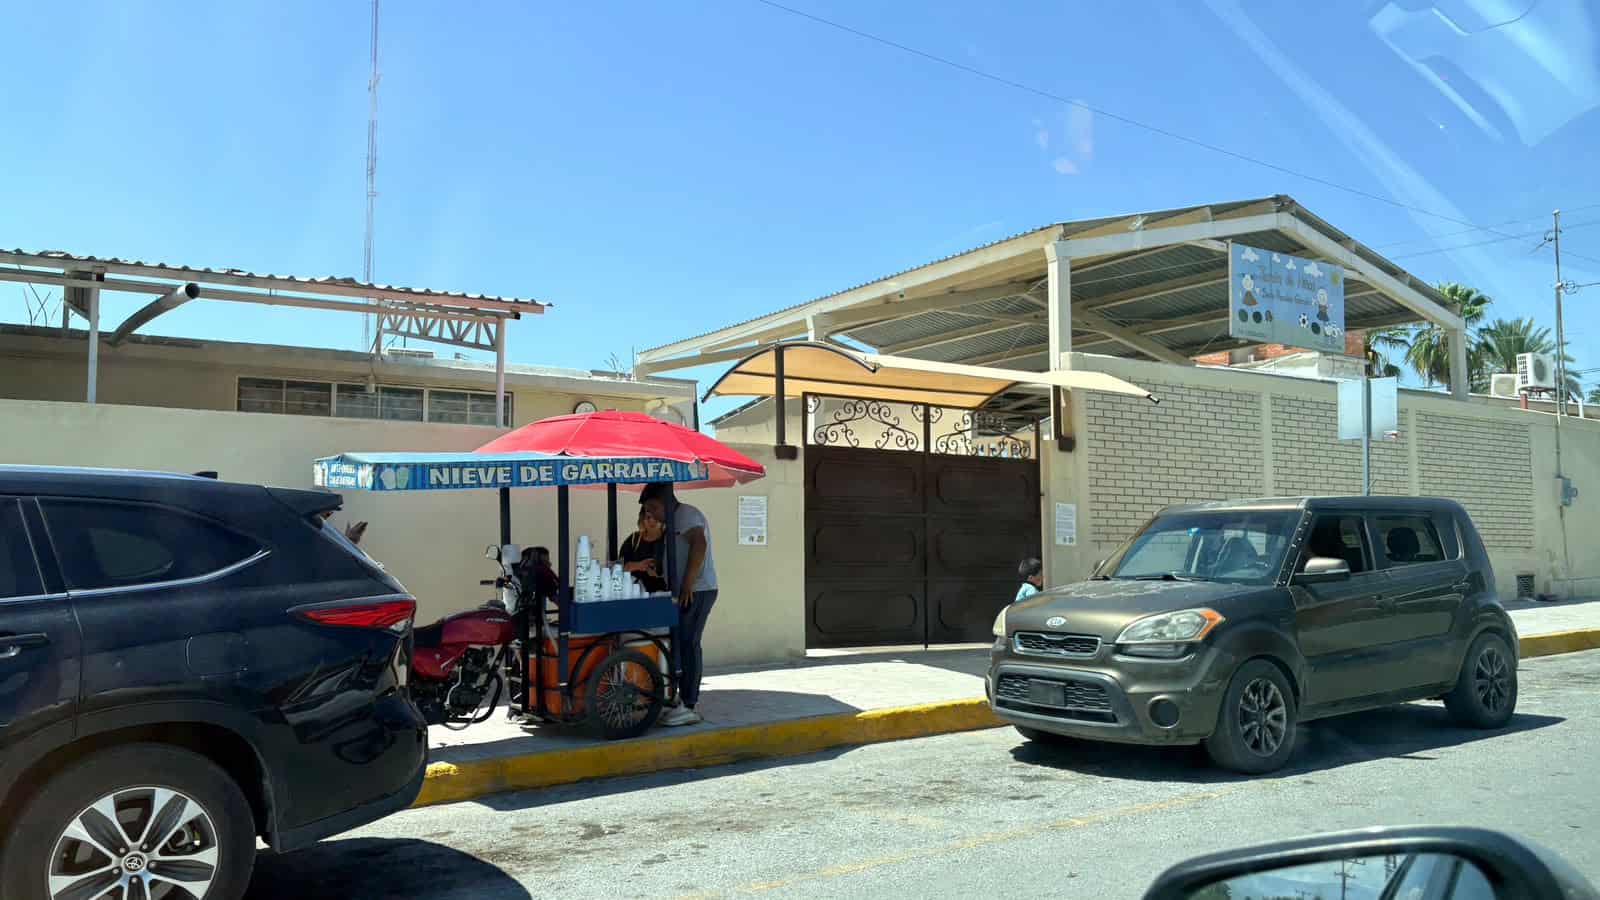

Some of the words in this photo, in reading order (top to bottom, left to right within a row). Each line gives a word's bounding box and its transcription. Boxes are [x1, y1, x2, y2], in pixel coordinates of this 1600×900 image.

[429, 466, 512, 485] NIEVE
[520, 465, 553, 482] DE
[562, 462, 674, 480] GARRAFA
